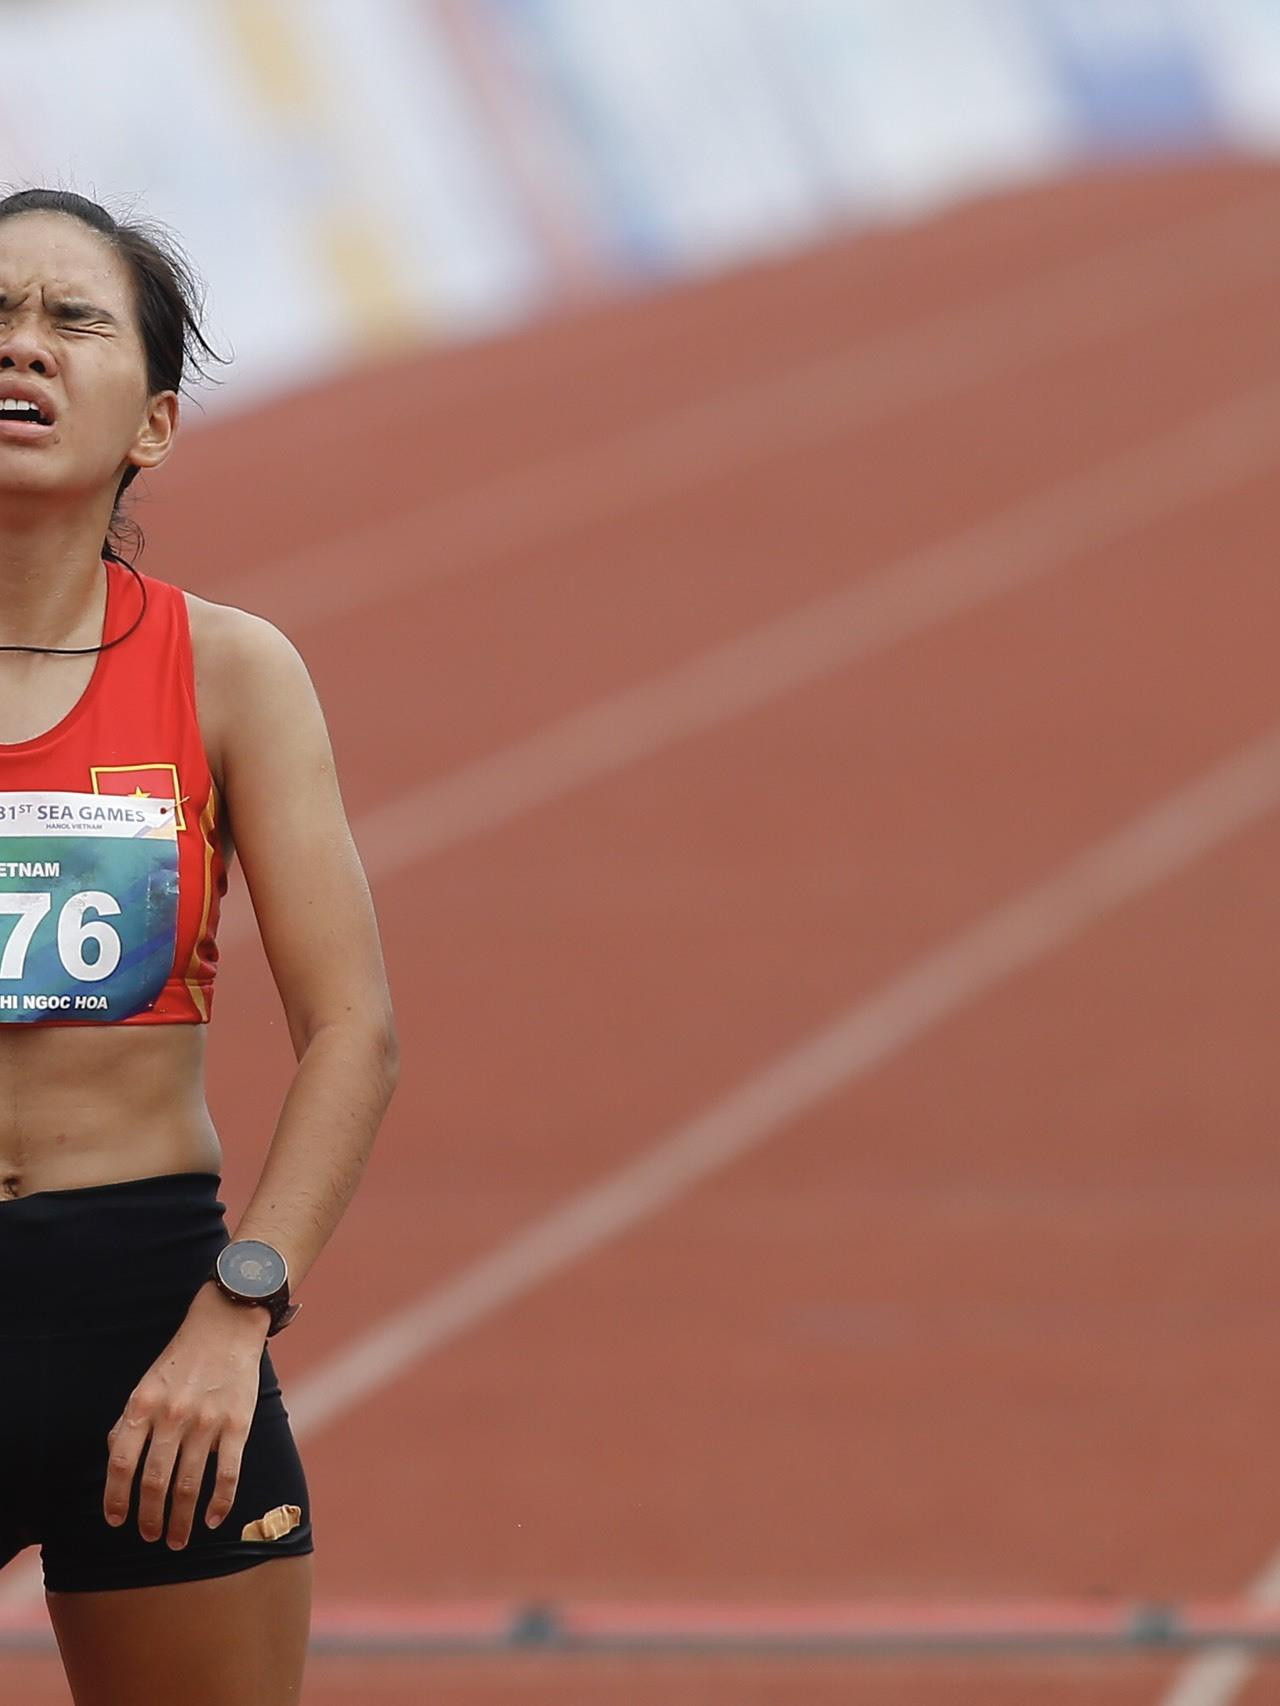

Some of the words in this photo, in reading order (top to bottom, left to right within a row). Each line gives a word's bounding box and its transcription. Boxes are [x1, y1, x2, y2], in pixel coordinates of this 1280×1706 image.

[37, 805, 74, 821] SEA
[78, 806, 146, 823] GAMES
[23, 995, 71, 1010] NGOC
[74, 995, 109, 1010] HOA
